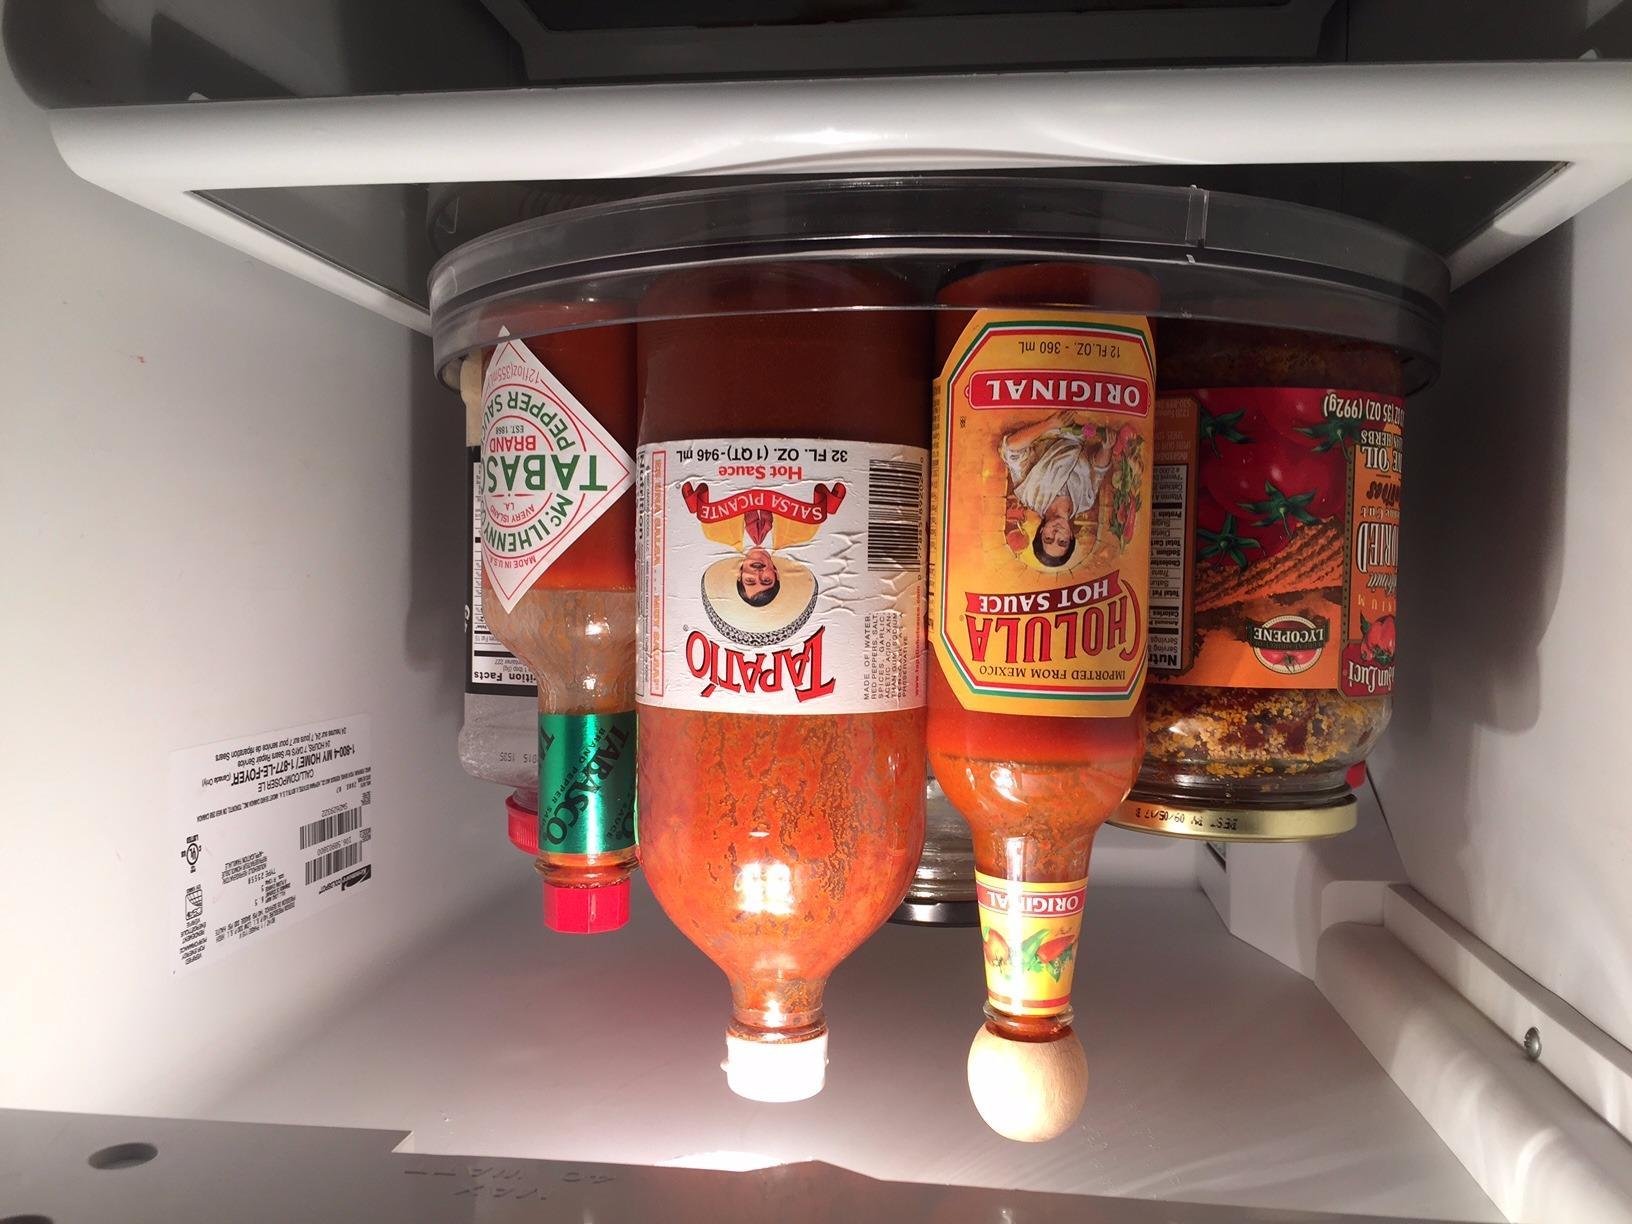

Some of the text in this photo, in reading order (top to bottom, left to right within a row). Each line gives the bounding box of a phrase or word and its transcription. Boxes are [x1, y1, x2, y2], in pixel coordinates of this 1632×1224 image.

[1018, 341, 1035, 354] mL
[1039, 341, 1061, 354] 360
[1110, 345, 1121, 358] 12
[985, 379, 1140, 407] ORIGINAL
[1323, 393, 1363, 419] (992g)
[1365, 399, 1381, 421] OZ)
[507, 391, 576, 452] PEPPER
[511, 425, 524, 434] EST.
[489, 435, 536, 453] BRAND
[1360, 429, 1392, 447] HERBS
[676, 449, 693, 463] mL
[774, 447, 799, 461] OZ.
[804, 448, 827, 462] FL.
[831, 449, 848, 462] 32
[1361, 446, 1389, 472] OIL
[480, 454, 608, 493] TABAS
[718, 465, 803, 481] Hot Sauce
[489, 504, 535, 523] AVERY ISLAND
[700, 492, 822, 522] SALSA PICANTE
[1360, 506, 1384, 520] Cut
[513, 555, 536, 568] MADE
[1150, 559, 1181, 567] Cholester
[978, 579, 1108, 612] HOT SAUCE
[964, 579, 1141, 664] CHOLULA
[1152, 610, 1179, 618] Calories
[1253, 627, 1324, 643] LYCOPENE
[685, 626, 836, 703] TAPATÍO
[473, 671, 537, 683] rition Facts
[979, 665, 1126, 681] IMPORTED FROM MEXICO
[321, 749, 333, 763] MY
[257, 780, 266, 792] LE
[545, 726, 629, 845] TABASCO
